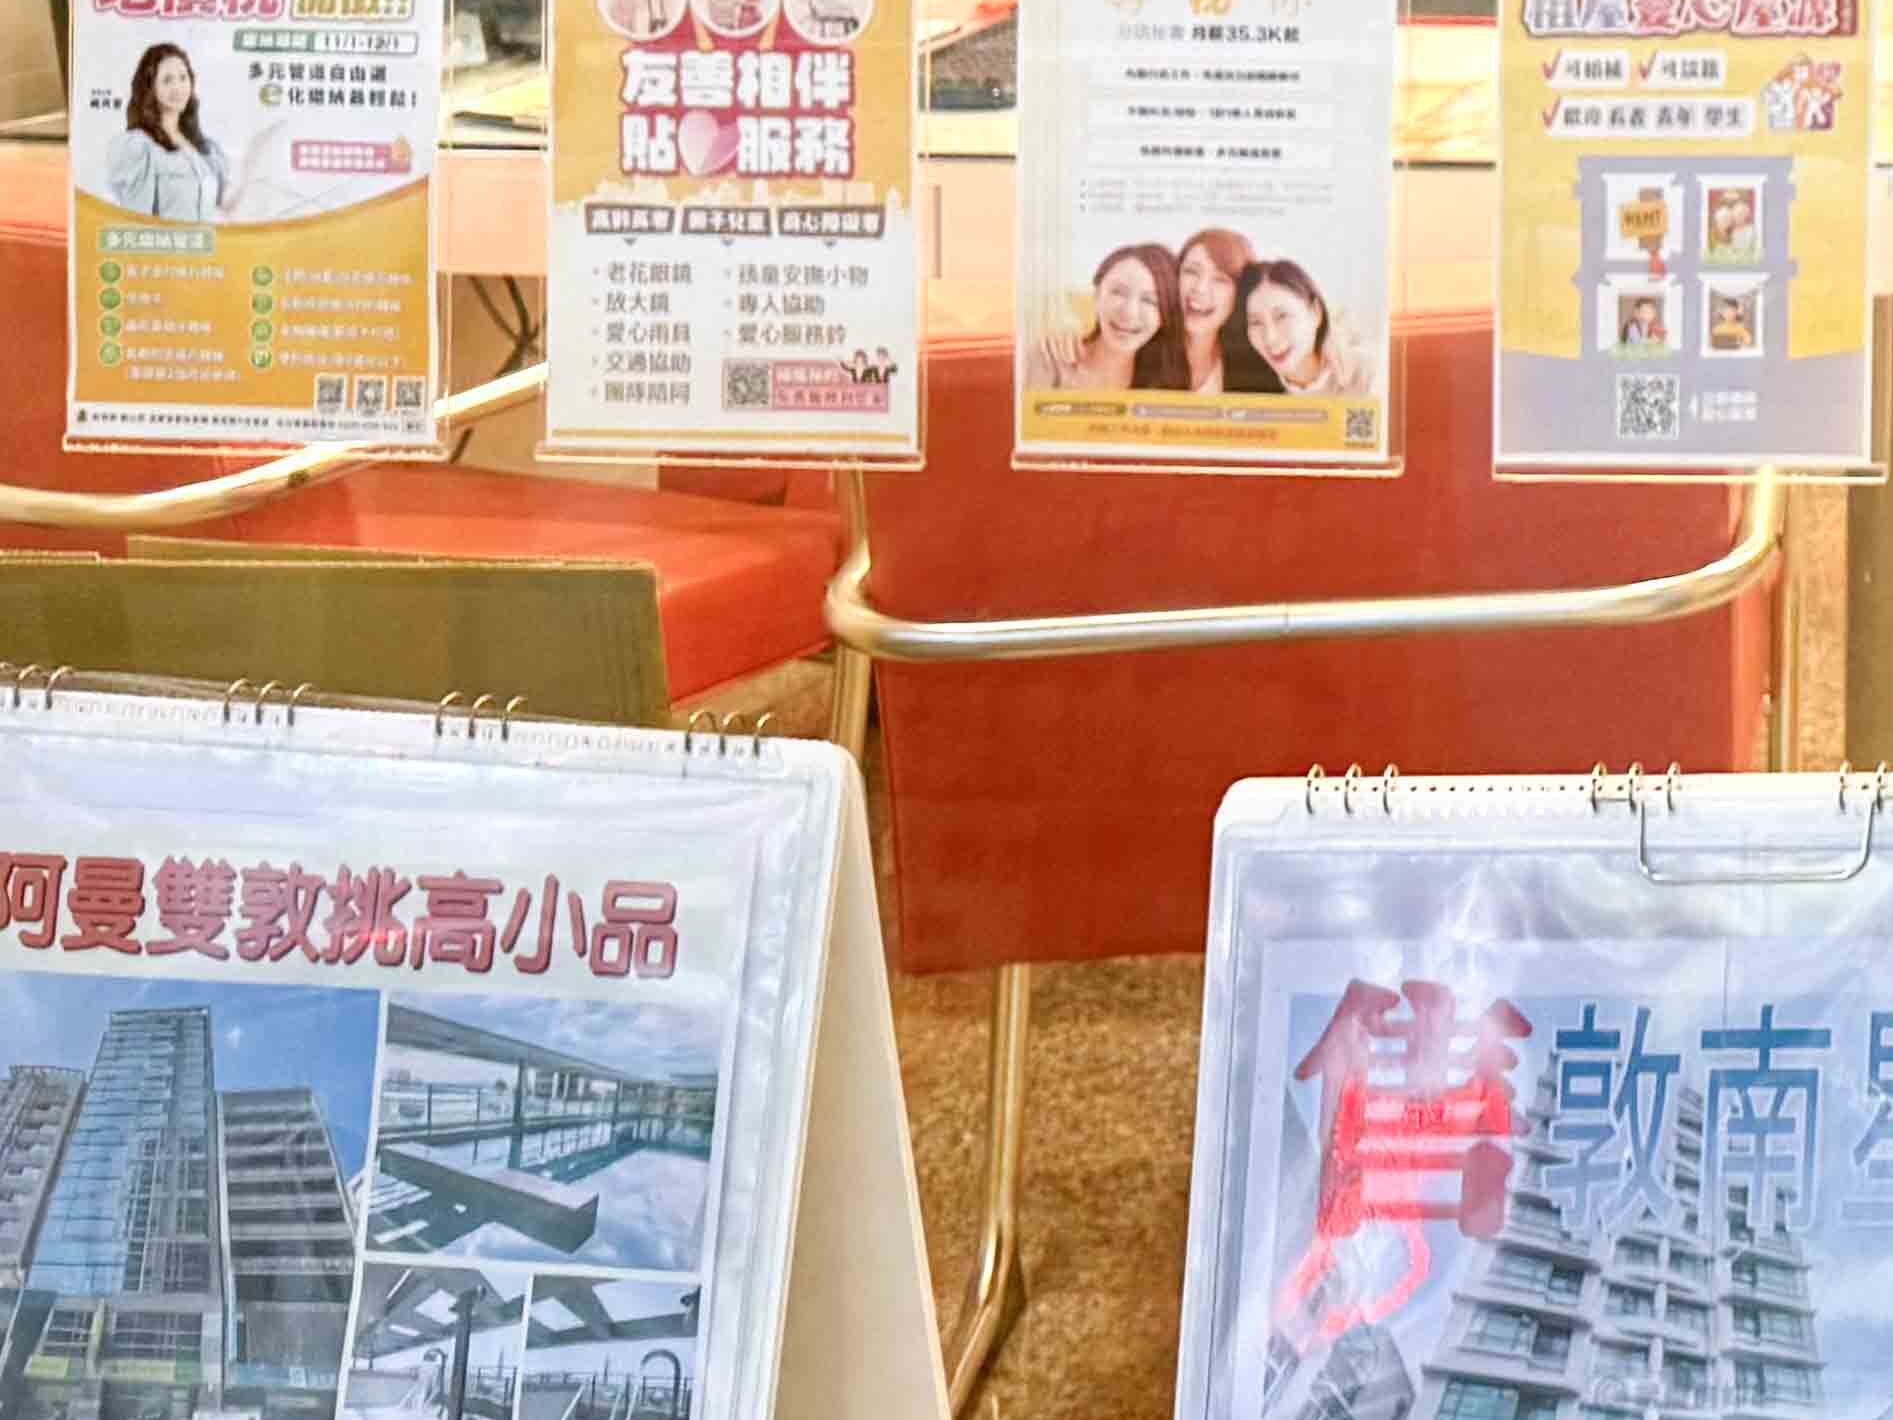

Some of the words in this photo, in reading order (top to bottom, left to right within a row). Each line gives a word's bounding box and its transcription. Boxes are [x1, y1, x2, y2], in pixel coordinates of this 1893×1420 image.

[623, 51, 852, 108] 友善相伴
[738, 115, 852, 177] 服務
[606, 294, 670, 314] 放大鏡
[0, 851, 681, 980] 阿曼雙敦挑高小品
